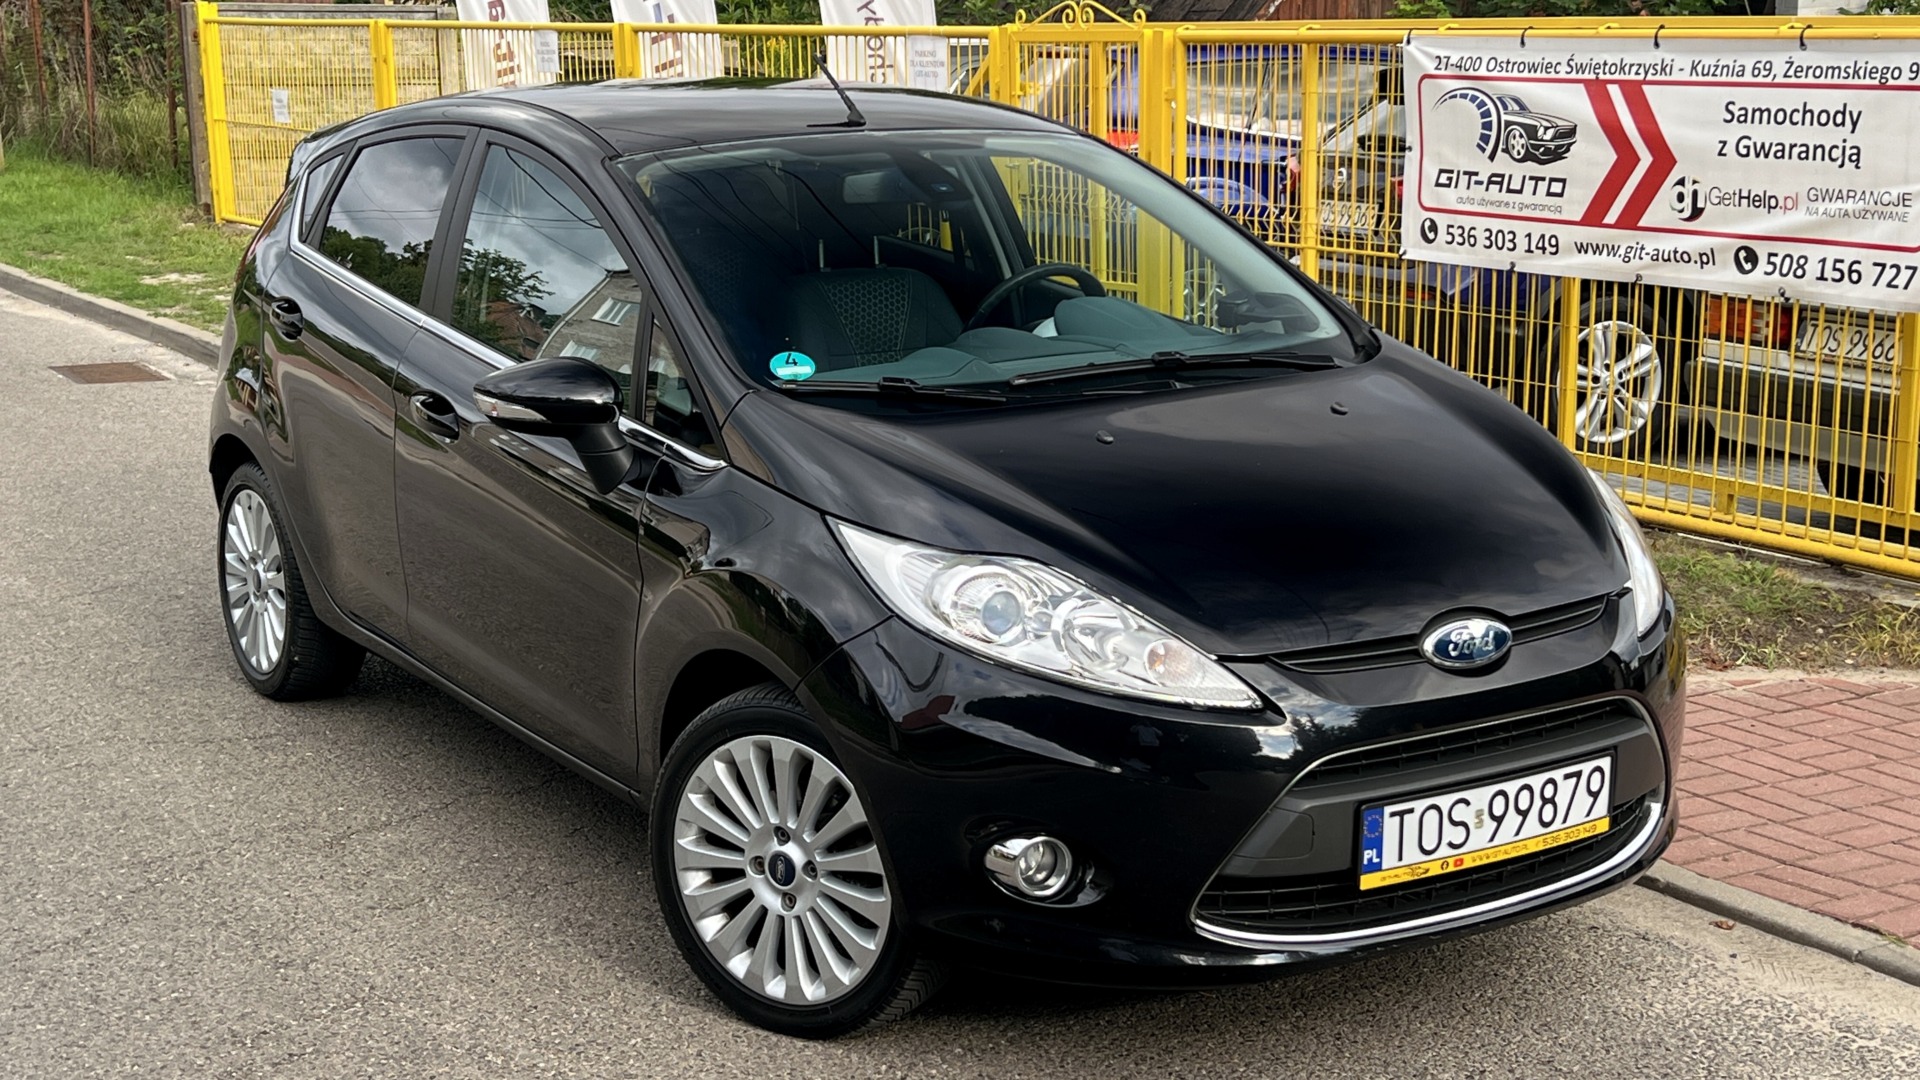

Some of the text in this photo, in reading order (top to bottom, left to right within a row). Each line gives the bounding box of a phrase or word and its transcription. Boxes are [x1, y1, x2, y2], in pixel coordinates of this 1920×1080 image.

[1434, 55, 1482, 73] 27-400
[1486, 56, 1562, 75] Ostrowiec
[1565, 53, 1675, 80] Świętokrzyski
[1689, 58, 1746, 78] Kuźnia
[1751, 60, 1777, 82] 69,
[1783, 56, 1903, 84] Żeromskiego
[1723, 100, 1863, 135] Samochody
[1717, 135, 1862, 170] z Gwarancją
[1434, 168, 1568, 198] GIT-AUTO
[1806, 186, 1914, 208] GWARANCJE
[1708, 186, 1799, 215] GetHelp.pl
[1804, 206, 1911, 223] NA AUTA UŻYWANE
[1445, 224, 1560, 256] 536 303 149
[1574, 240, 1716, 269] www.git-auto.pl
[1763, 251, 1919, 291] 508 156 727
[1807, 323, 1844, 353] TOS
[785, 353, 798, 366] 4
[1448, 628, 1494, 657] Ford
[1389, 765, 1606, 862] TOS 99879
[1363, 848, 1380, 865] PL
